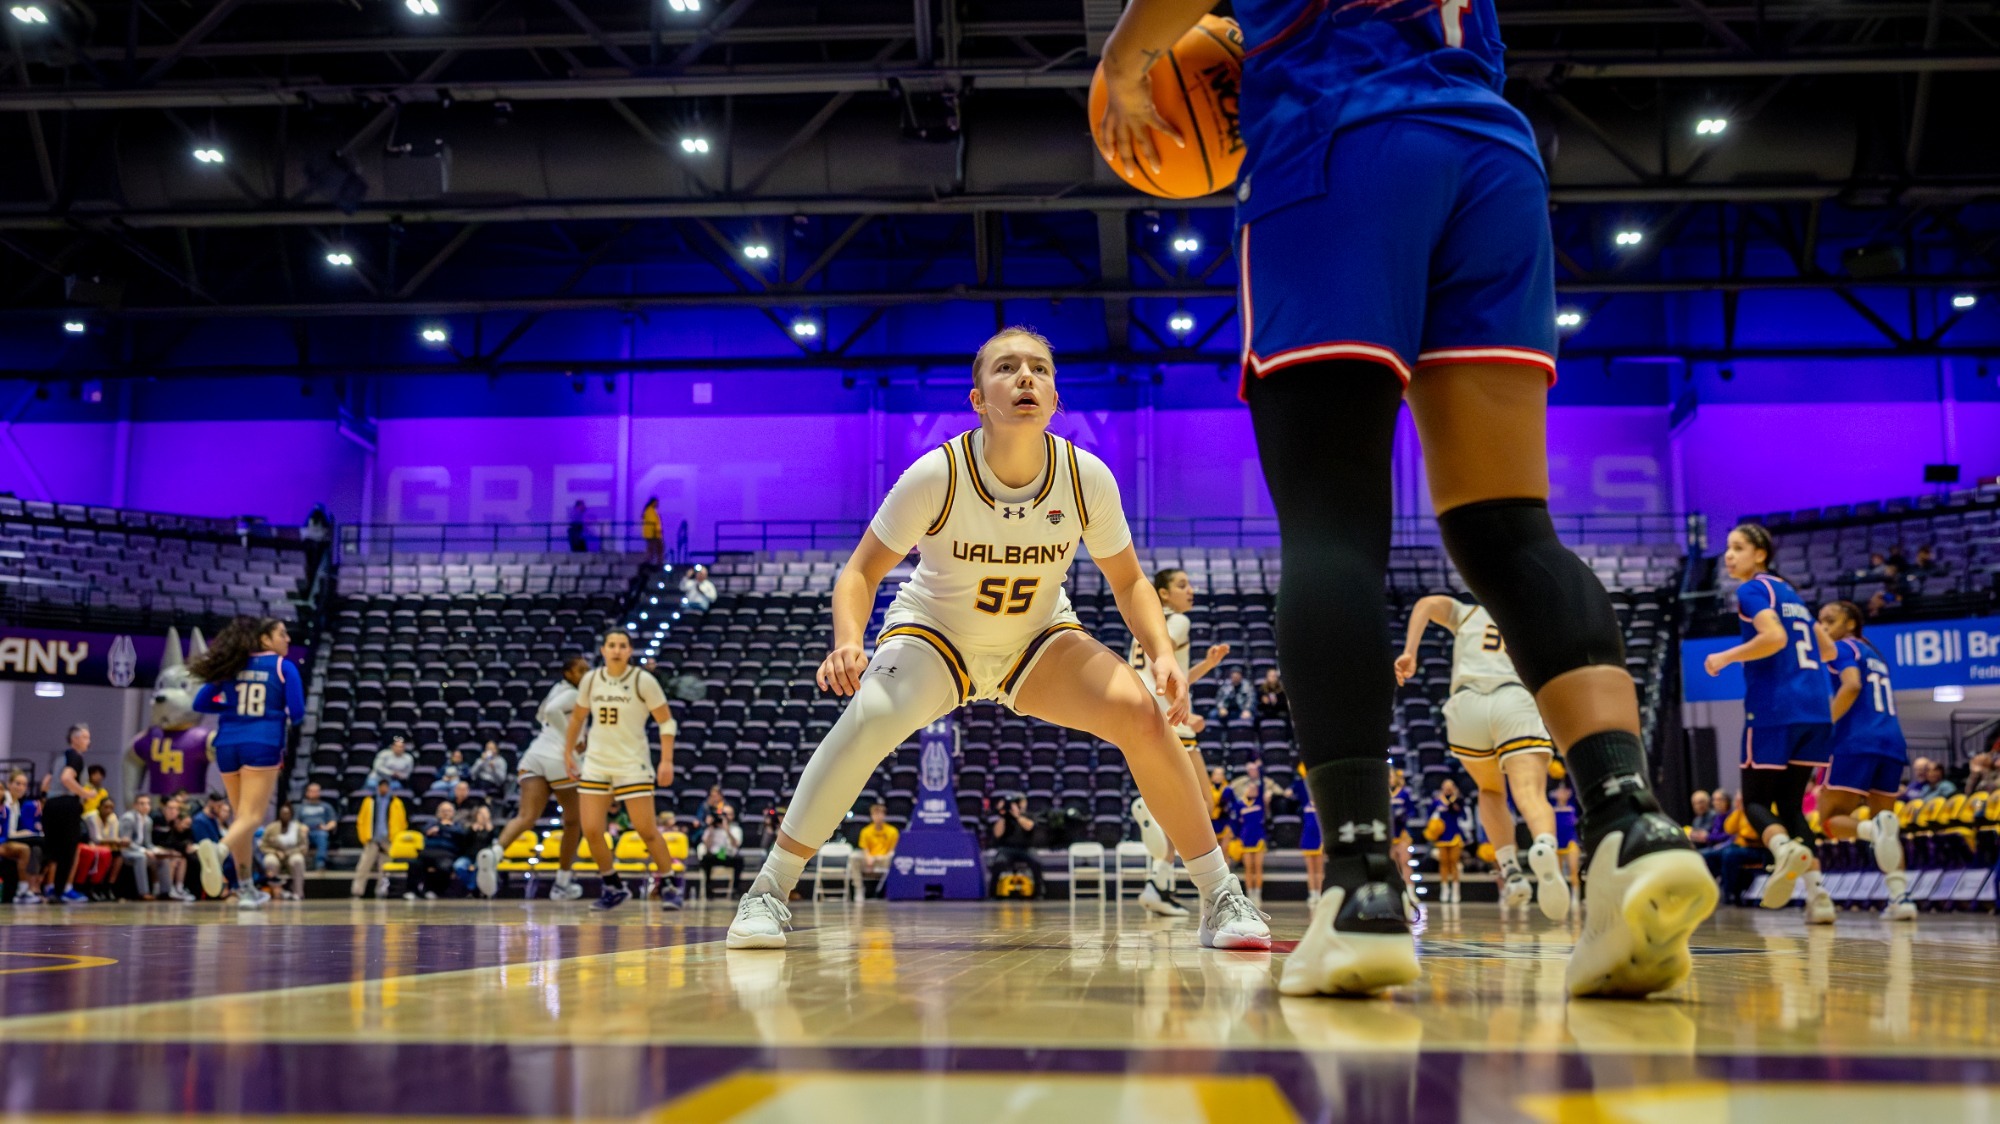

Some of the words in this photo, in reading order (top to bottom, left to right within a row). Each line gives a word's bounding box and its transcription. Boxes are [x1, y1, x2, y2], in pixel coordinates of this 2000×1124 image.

[386, 463, 782, 537] GREAT
[953, 540, 1070, 564] UALBANY
[974, 576, 1041, 616] 55
[0, 637, 89, 676] ANY
[1793, 621, 1819, 670] 2
[235, 682, 266, 717] 18
[1866, 671, 1896, 716] 11
[599, 706, 618, 725] 33
